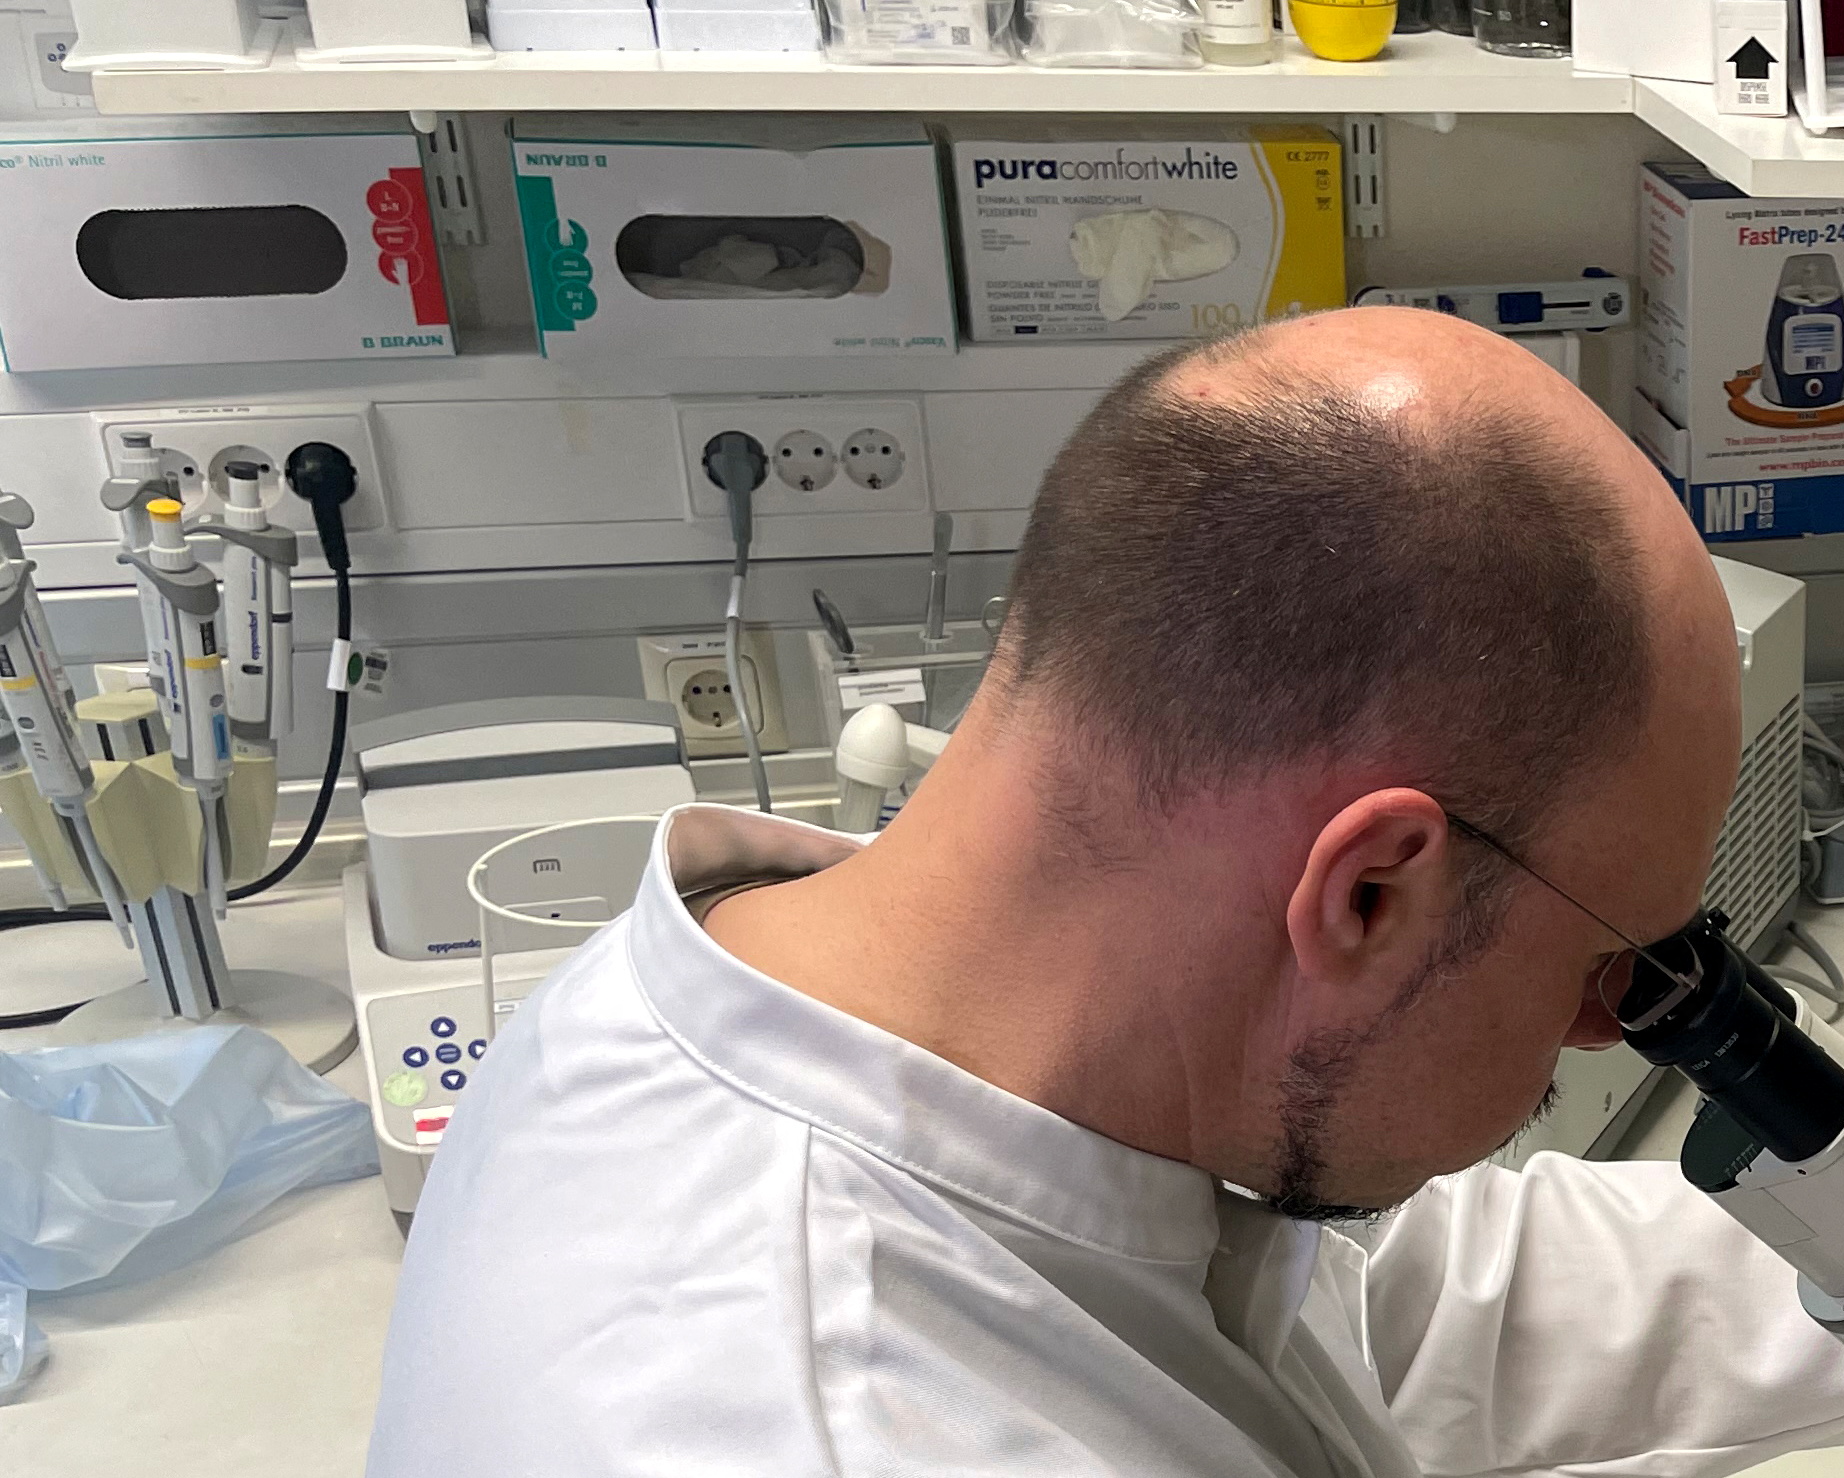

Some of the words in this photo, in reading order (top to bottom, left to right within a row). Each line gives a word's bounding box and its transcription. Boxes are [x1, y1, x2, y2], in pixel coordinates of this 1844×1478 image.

[0, 156, 24, 168] co®
[29, 155, 63, 168] Nitril
[68, 154, 106, 167] white
[526, 154, 590, 168] BRAUN
[381, 335, 445, 348] BRAUN
[1703, 484, 1758, 535] MP
[427, 938, 481, 954] eppendo
